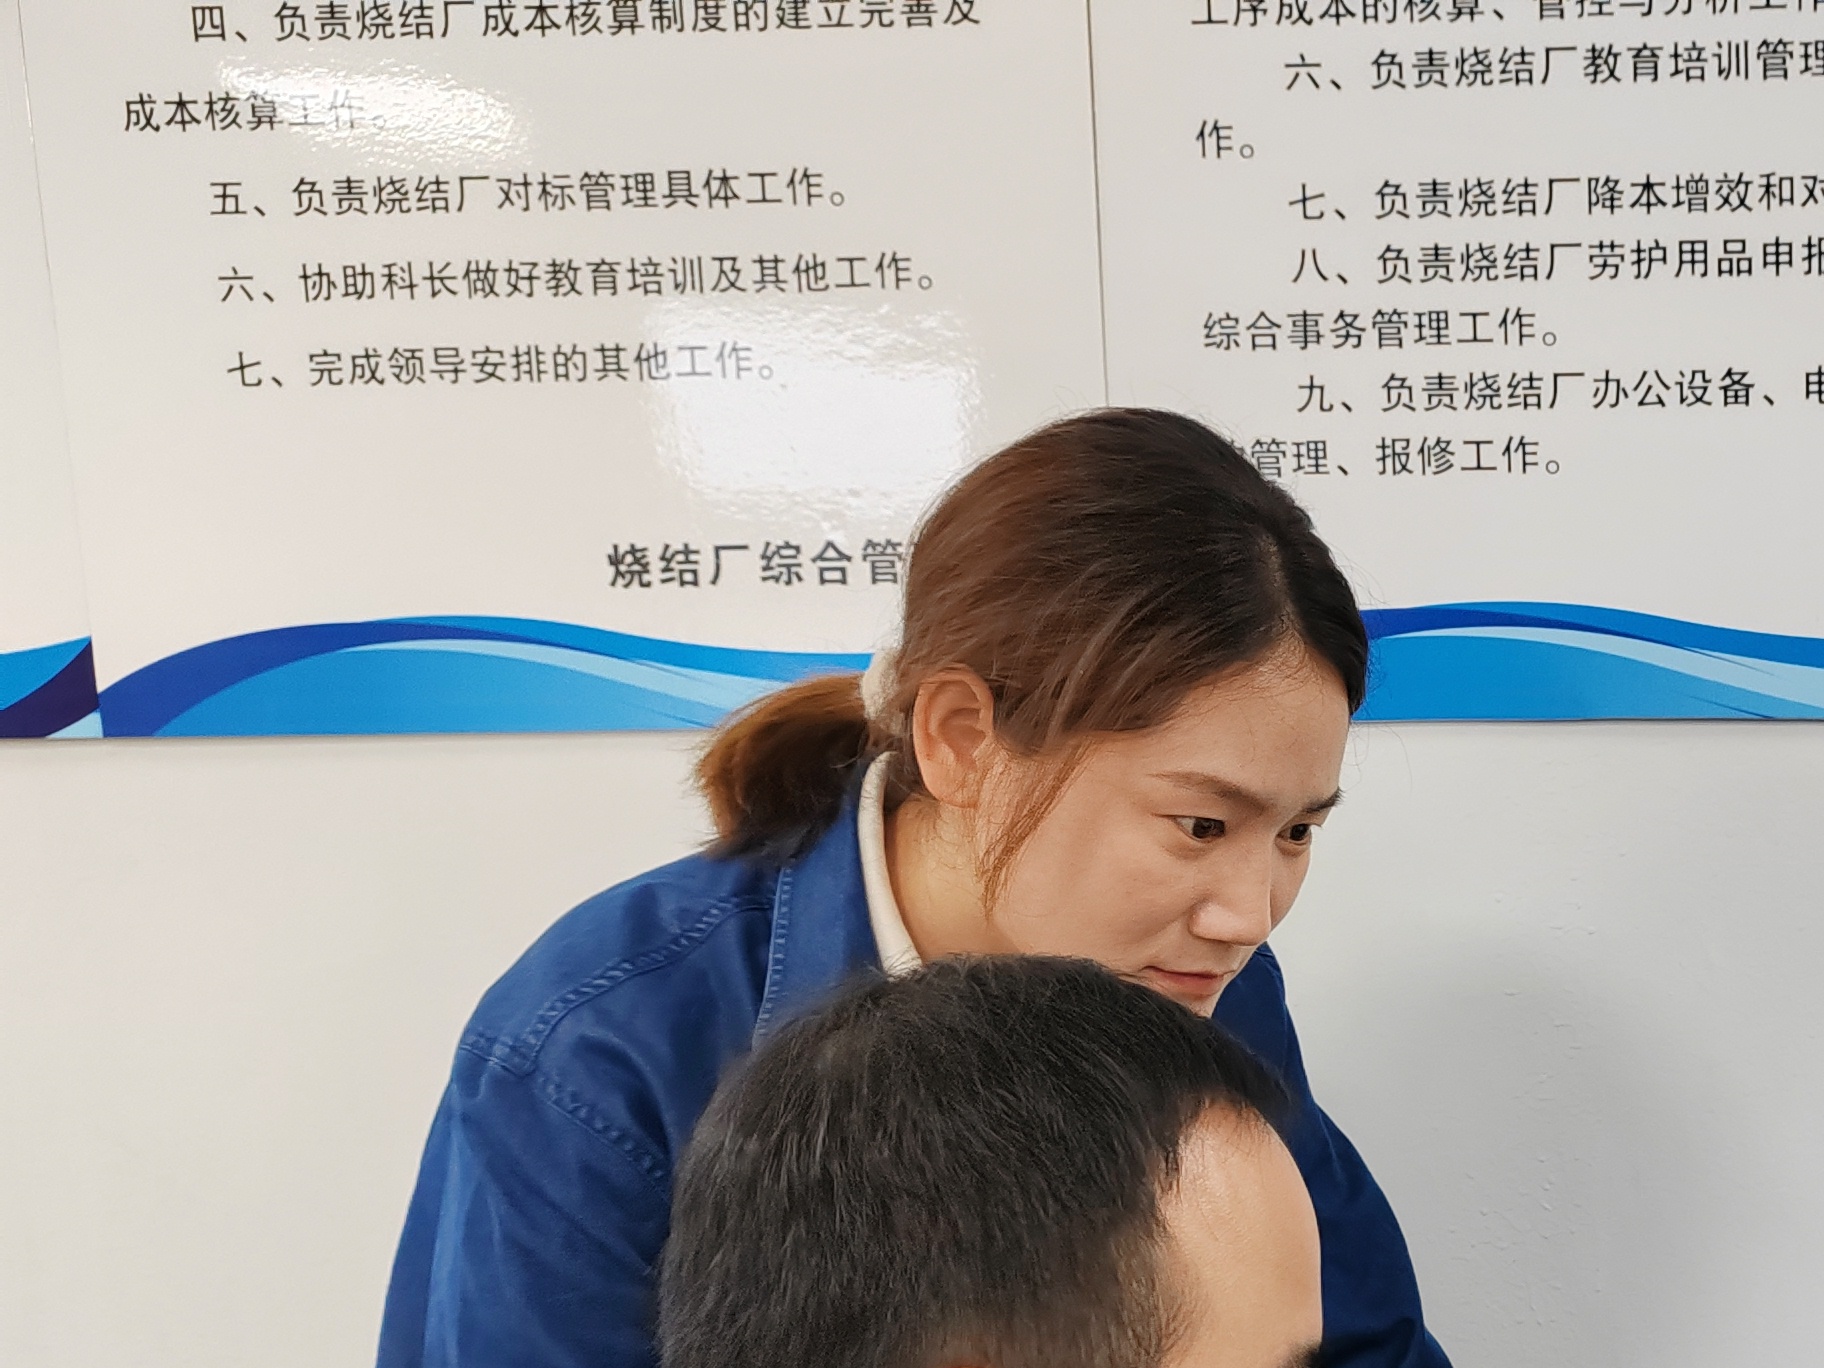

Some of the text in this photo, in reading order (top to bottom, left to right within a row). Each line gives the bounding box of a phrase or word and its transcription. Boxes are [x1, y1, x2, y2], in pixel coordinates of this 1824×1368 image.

[1195, 118, 1257, 161] 作。
[209, 166, 848, 218] 五、负责烧结厂对标管理具体工作。
[217, 250, 938, 304] 六、协助科长做好教育培训及其他工作。
[1203, 306, 1560, 352] 综合事务管理工作。
[226, 341, 777, 389] 七、完成领导安排的其他工作。
[1230, 434, 1561, 478] 管理、报修工作。
